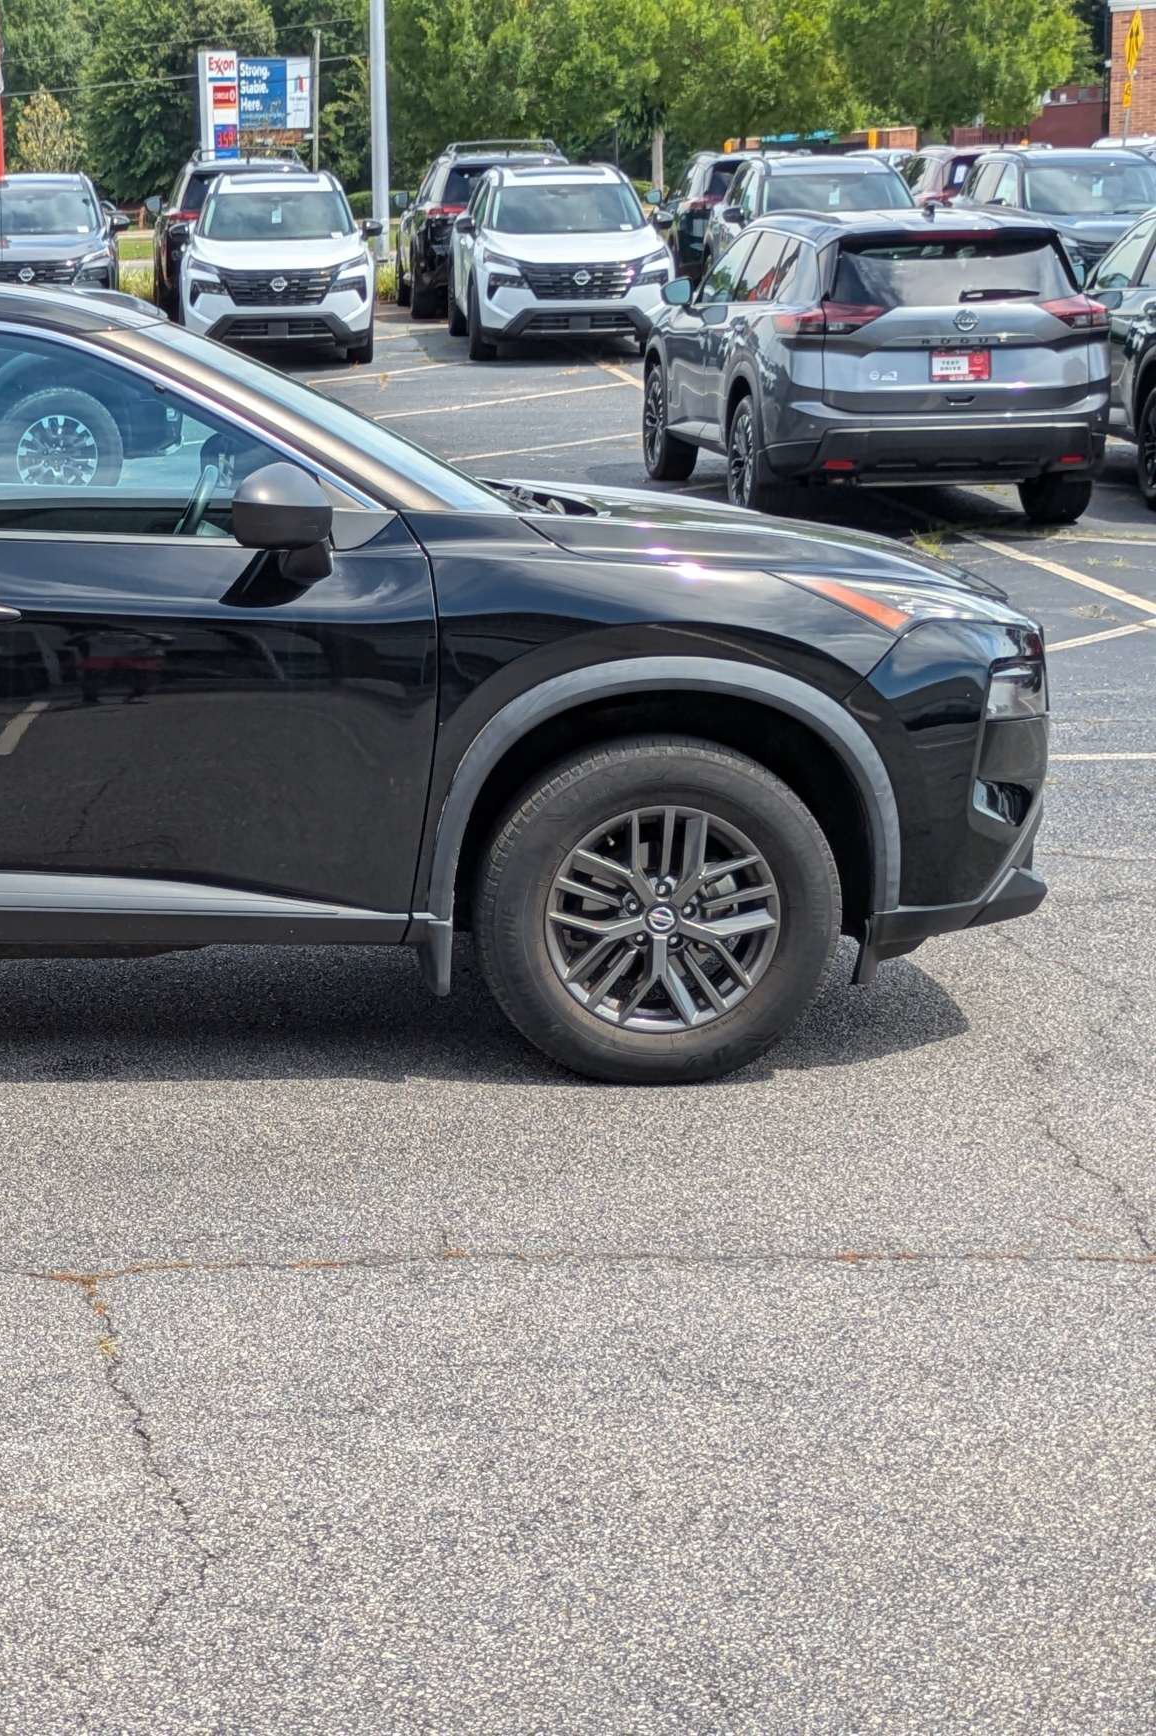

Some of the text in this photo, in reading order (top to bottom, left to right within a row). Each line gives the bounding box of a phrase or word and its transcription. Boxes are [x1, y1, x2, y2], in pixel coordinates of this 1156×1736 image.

[208, 56, 235, 75] Exxon
[239, 62, 270, 79] Strong.
[239, 80, 269, 94] Stable.
[240, 98, 263, 112] Here.
